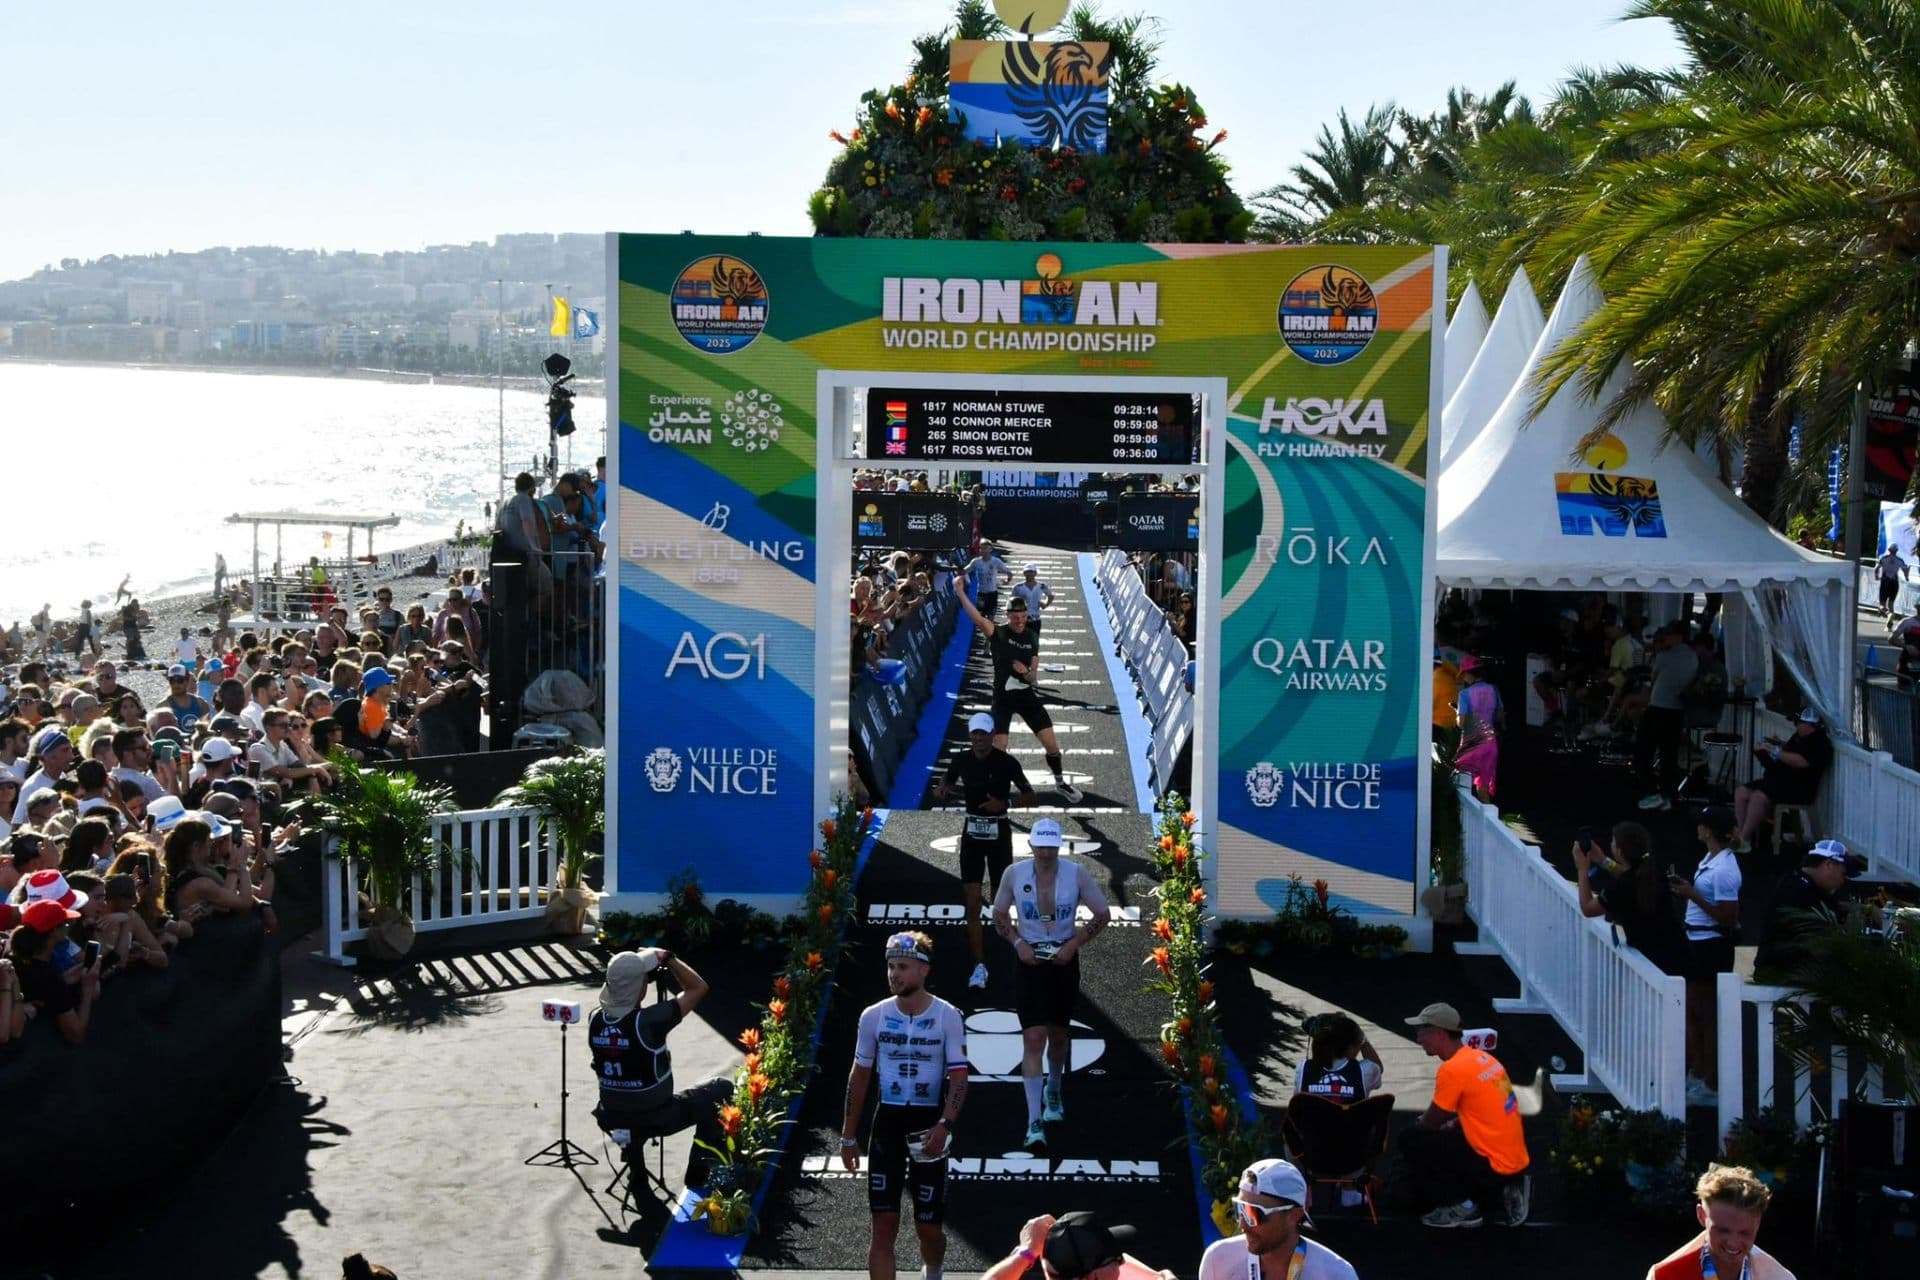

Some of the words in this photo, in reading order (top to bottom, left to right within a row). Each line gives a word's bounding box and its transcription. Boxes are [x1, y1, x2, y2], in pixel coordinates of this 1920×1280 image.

[677, 320, 705, 329] WORLD
[705, 321, 766, 330] CHAMPIONSHIP
[706, 338, 731, 348] 2025
[882, 328, 968, 349] WORLD
[975, 330, 1156, 353] CHAMPIONSHIP
[1284, 331, 1312, 340] WORLD
[1313, 331, 1374, 340] CHAMPIONSHIP
[1313, 349, 1338, 358] 2025
[650, 394, 712, 406] Experience
[922, 401, 946, 411] 1817
[953, 402, 1002, 412] NORMAN
[1005, 403, 1045, 413] STUWE
[1114, 405, 1158, 415] 09:28:14
[928, 416, 946, 426] 340
[953, 417, 1001, 427] CONNOR
[1004, 417, 1052, 428] MERCER
[1113, 419, 1158, 430] 09:59:08
[1258, 397, 1388, 436] HOKA
[648, 428, 712, 444] OMAN
[928, 431, 946, 440] 265
[952, 431, 989, 441] SIMON
[991, 432, 1030, 442] BONTE
[1113, 434, 1158, 444] 09:59:06
[922, 445, 946, 455] 1617
[952, 445, 984, 456] ROSS
[986, 446, 1033, 457] WELTON
[1112, 449, 1157, 459] 09:36:00
[1258, 443, 1287, 457] FLY
[1289, 443, 1357, 458] HUMAN
[1358, 444, 1387, 458] FLY
[985, 488, 1015, 497] WORLD
[1017, 489, 1080, 498] CHAMPIONSH
[1129, 515, 1165, 526] QATAR
[629, 537, 804, 561] BREITLING
[694, 567, 739, 584] 1884
[664, 632, 766, 680] AG1
[1252, 638, 1387, 675] QATAR
[1286, 672, 1387, 691] AIRWAYS
[688, 747, 743, 766] VILLE
[751, 748, 778, 767] DE
[1289, 761, 1346, 780] VILLE
[1352, 762, 1381, 781] DE
[688, 766, 777, 795] NICE
[1290, 780, 1381, 810] NICE
[604, 1061, 622, 1077] 81
[801, 1172, 868, 1180] WORL
[1073, 1175, 1161, 1183] EVENTS
